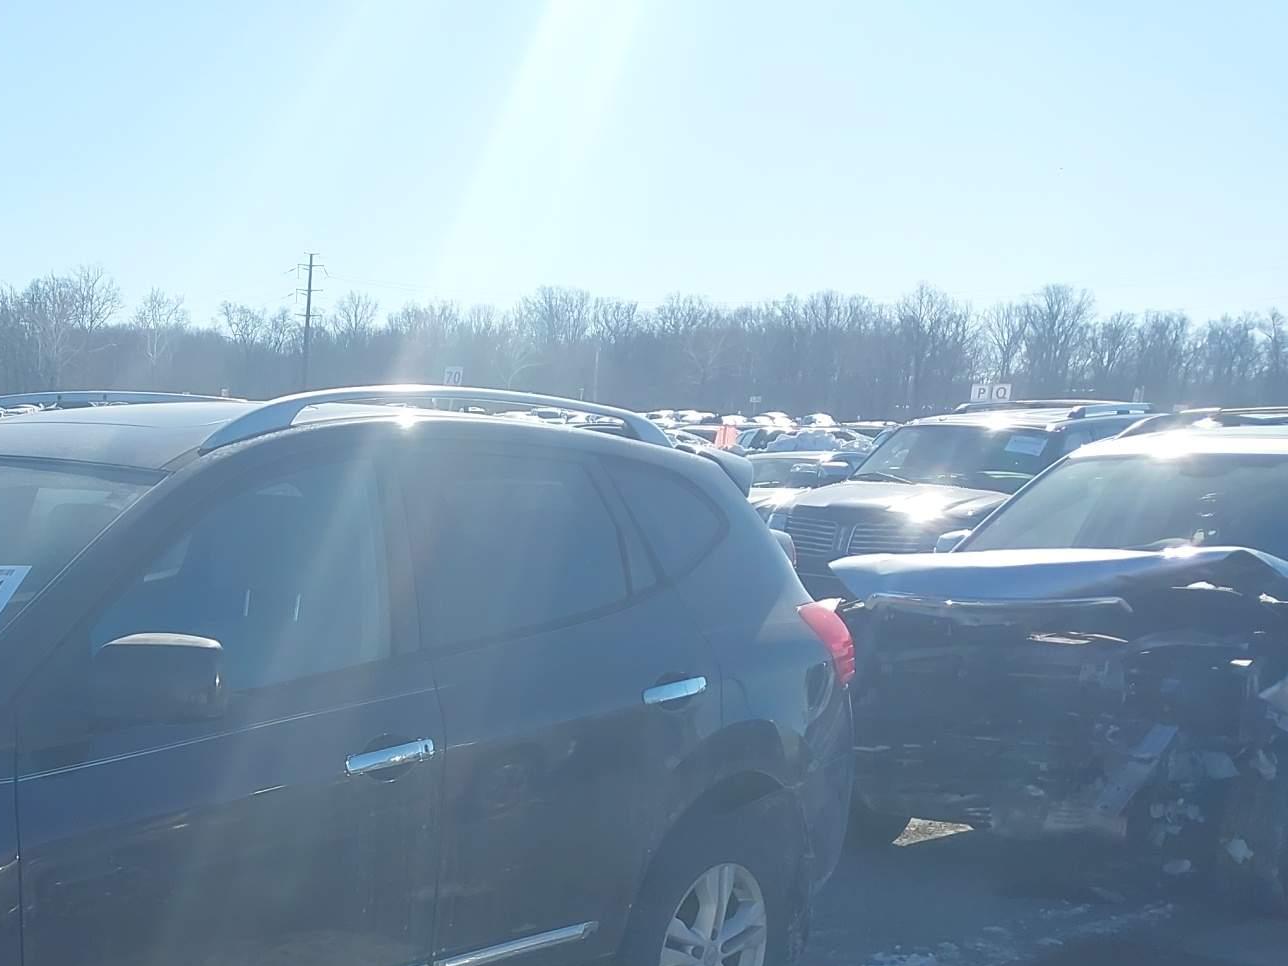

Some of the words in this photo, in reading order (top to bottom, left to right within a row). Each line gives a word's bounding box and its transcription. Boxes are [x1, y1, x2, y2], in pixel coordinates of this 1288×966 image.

[446, 370, 461, 385] 70
[977, 387, 986, 399] P
[996, 386, 1008, 400] Q
